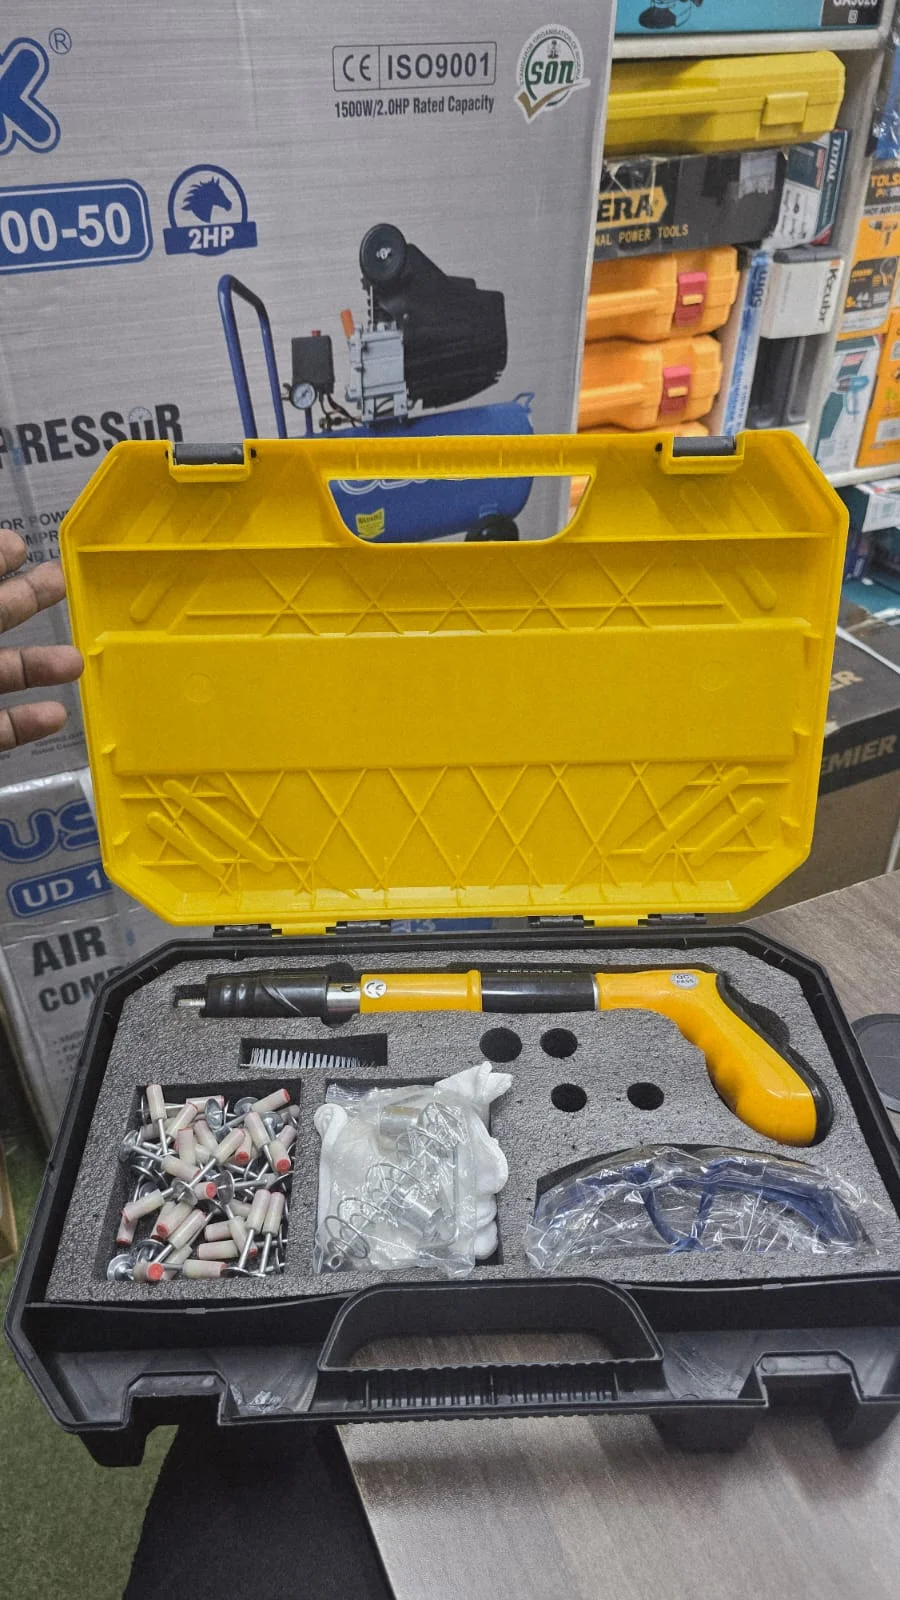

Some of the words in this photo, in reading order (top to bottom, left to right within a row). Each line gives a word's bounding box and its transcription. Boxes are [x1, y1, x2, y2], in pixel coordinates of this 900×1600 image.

[387, 52, 489, 80] ISO9001
[335, 98, 409, 118] 1500W/2.0HP
[413, 97, 444, 113] Rated
[447, 94, 494, 114] Capacity
[826, 137, 842, 182] TOTAL
[0, 202, 132, 254] 00-50
[187, 226, 235, 250] 2HP
[618, 228, 651, 244] POWER
[657, 223, 689, 239] TOOLS
[28, 510, 69, 526] POW
[22, 878, 74, 908] UD
[86, 868, 102, 889] 1
[32, 926, 108, 977] AIR
